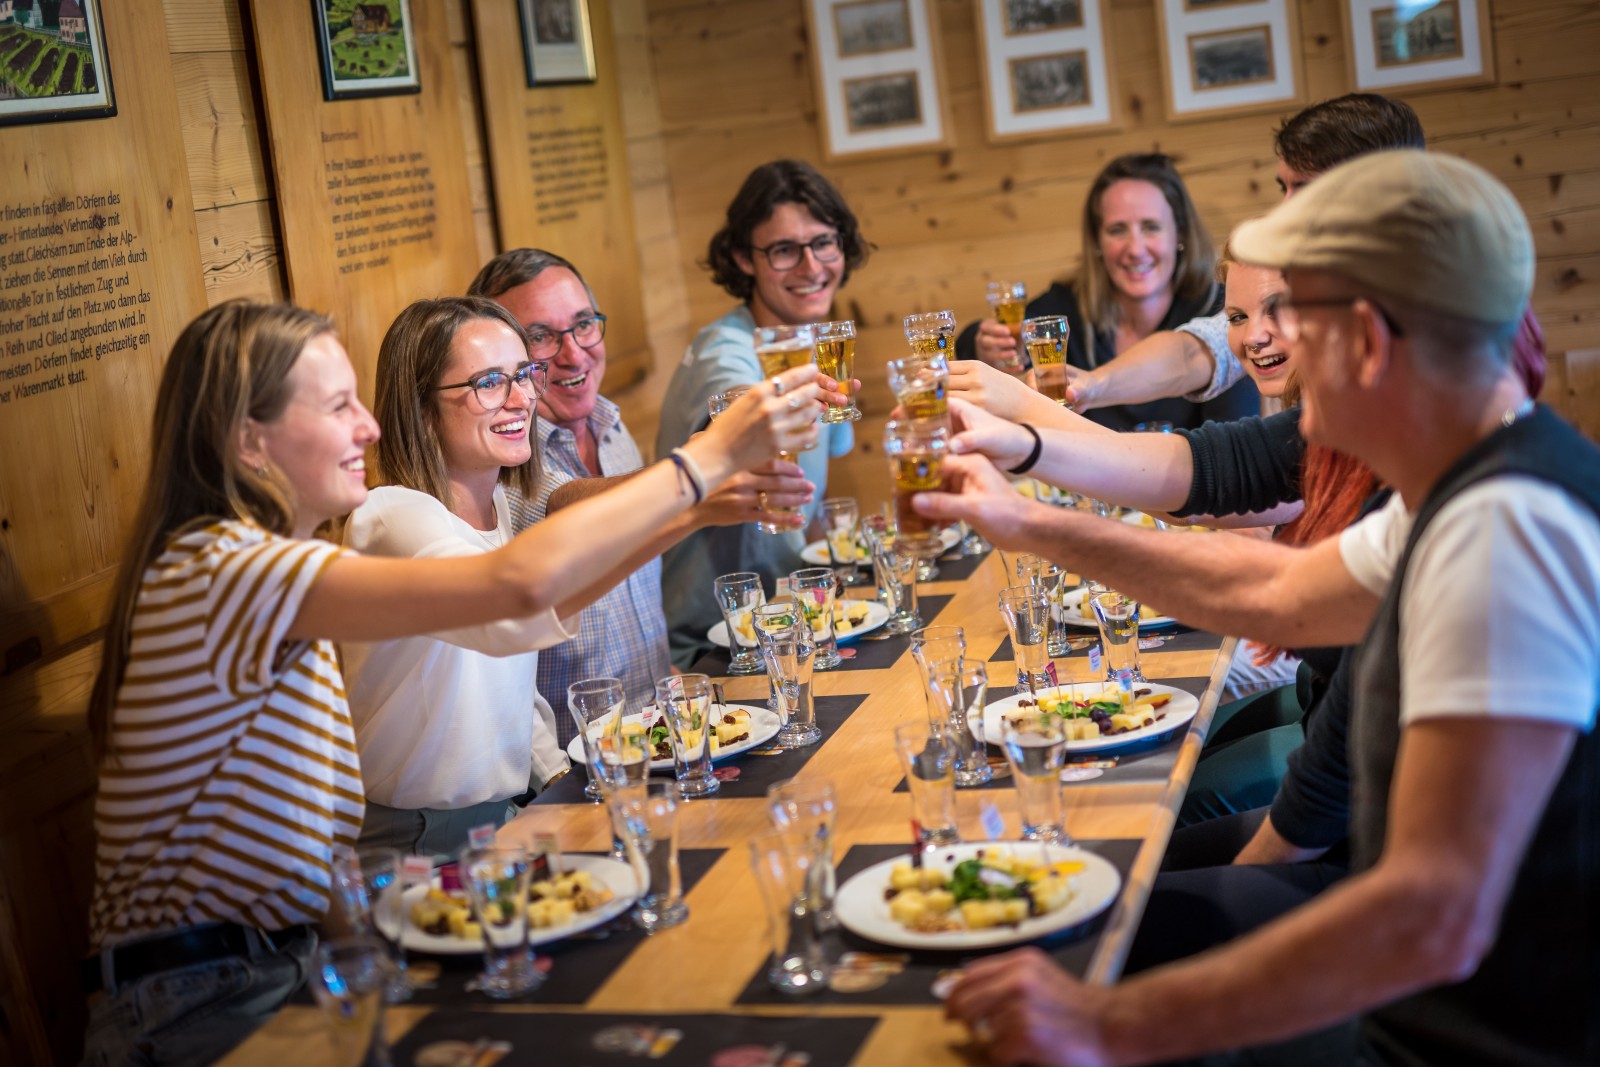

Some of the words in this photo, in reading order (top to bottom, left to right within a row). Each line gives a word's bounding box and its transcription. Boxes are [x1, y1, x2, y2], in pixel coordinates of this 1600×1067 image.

[5, 204, 31, 220] finden
[33, 203, 40, 217] in
[76, 194, 106, 210] Dörfern
[107, 190, 120, 206] des
[108, 211, 120, 227] mit
[69, 242, 86, 255] zum
[86, 233, 105, 250] Ende
[106, 231, 118, 248] der
[5, 270, 31, 289] ziehen
[33, 267, 47, 283] die
[47, 264, 76, 281] Sennen
[77, 260, 91, 275] mit
[92, 256, 109, 272] dem
[108, 251, 126, 268] Vieh
[128, 247, 148, 264] durch
[31, 290, 44, 306] Tor
[46, 288, 54, 303] in
[56, 281, 96, 301] festlichem
[97, 276, 114, 294] Zug
[114, 271, 129, 288] und
[24, 312, 50, 330] Tracht
[52, 305, 65, 323] auf
[67, 303, 82, 319] den
[118, 292, 137, 308] dann
[137, 289, 151, 305] das
[26, 332, 43, 352] und
[46, 327, 67, 347] Glied
[70, 317, 118, 344] angebunden
[35, 351, 68, 372] Dörfern
[70, 343, 93, 363] findet
[95, 333, 138, 361] gleichzeitig
[139, 329, 151, 345] ein
[12, 373, 65, 399] Warenmarkt
